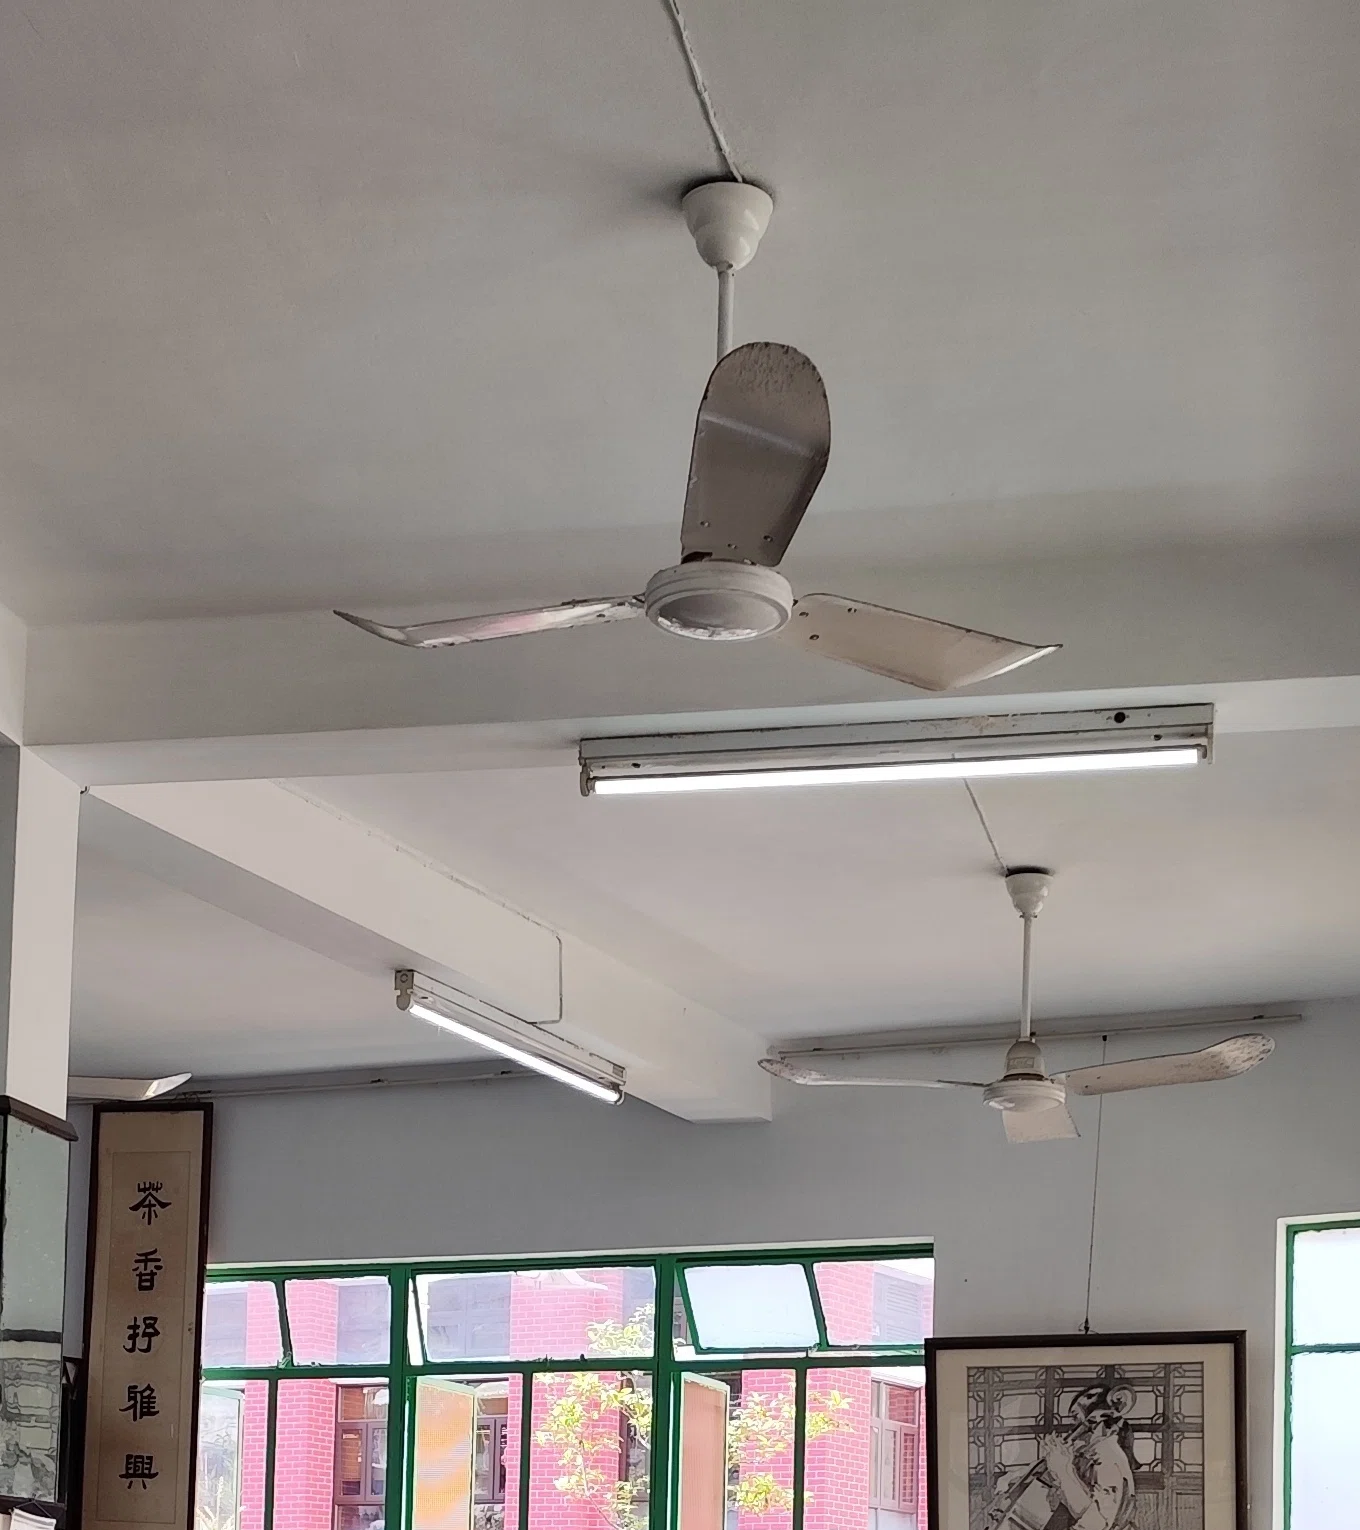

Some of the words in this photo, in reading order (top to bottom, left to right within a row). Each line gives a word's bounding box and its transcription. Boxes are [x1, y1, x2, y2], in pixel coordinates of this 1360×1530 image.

[118, 1181, 172, 1490] 茶香抒雅興
